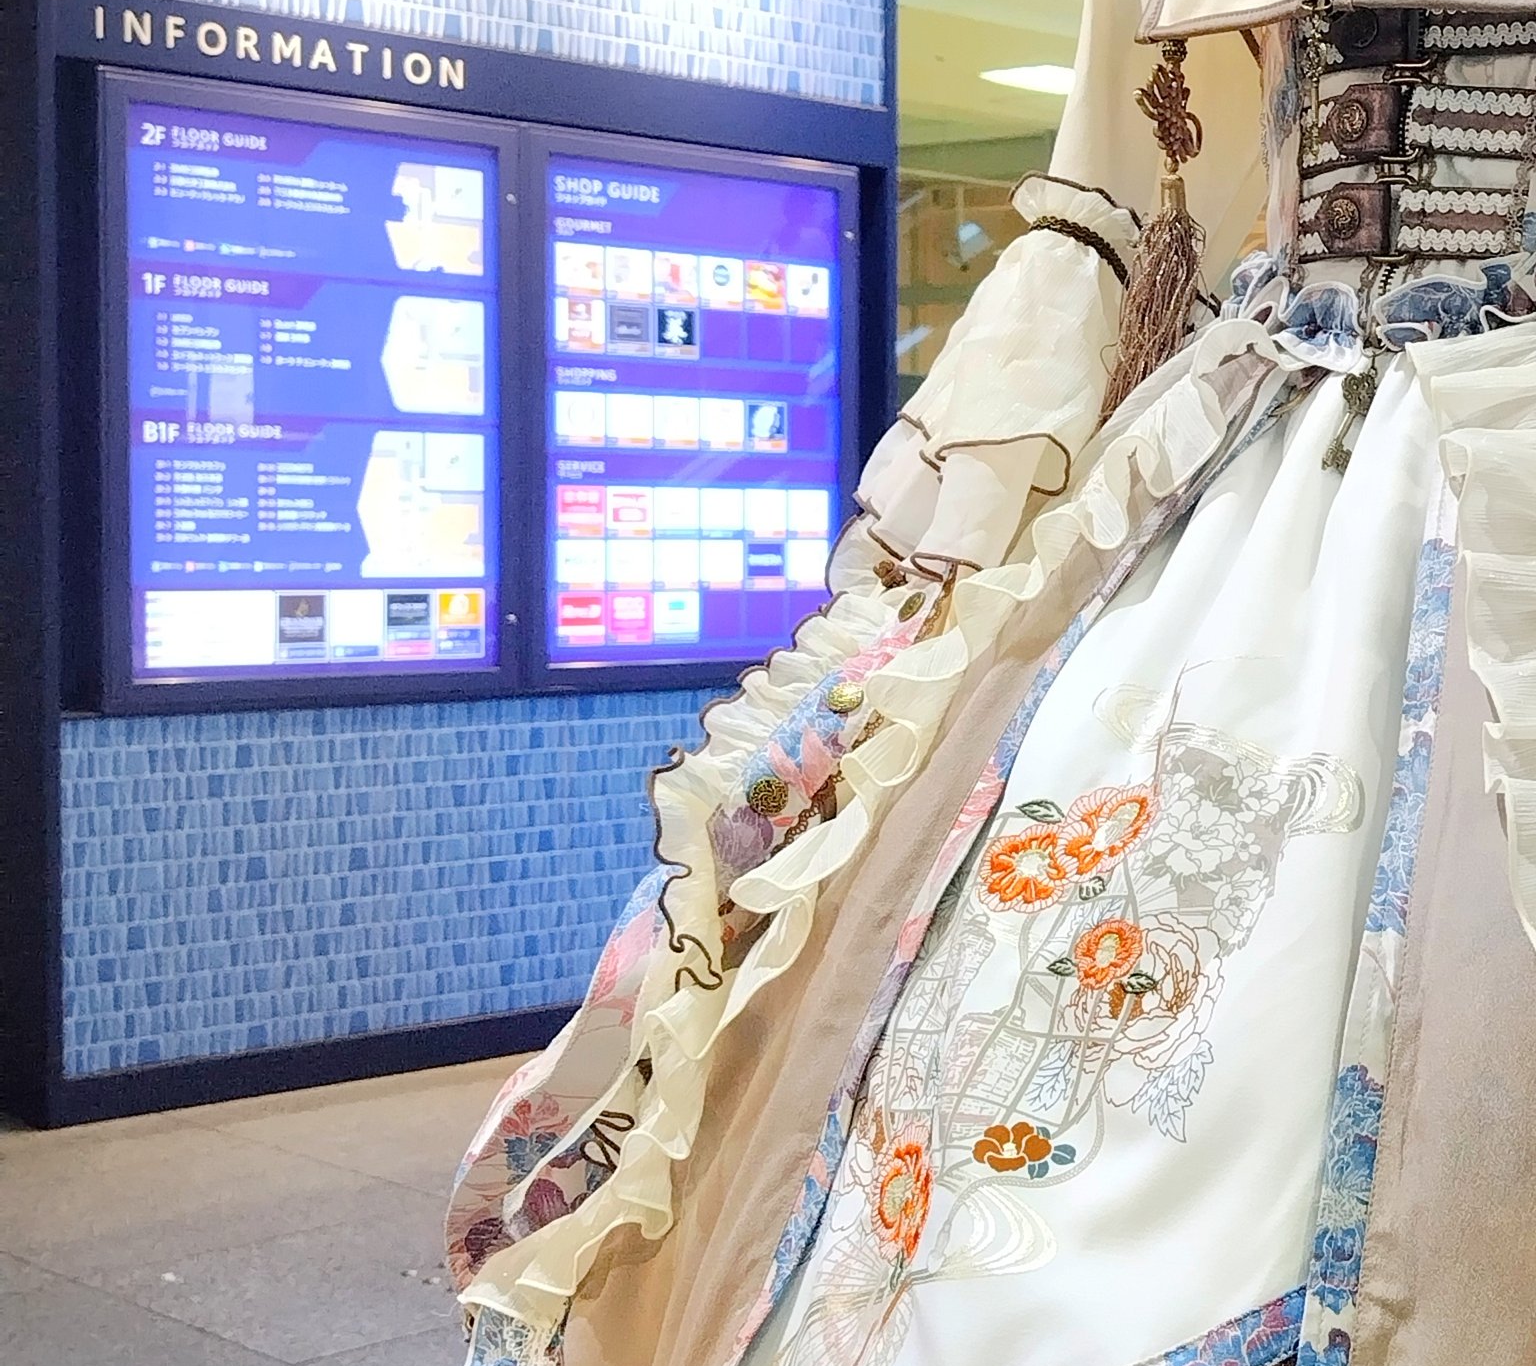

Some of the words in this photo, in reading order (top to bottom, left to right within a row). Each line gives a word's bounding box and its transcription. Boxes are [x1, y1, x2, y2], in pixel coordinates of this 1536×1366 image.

[94, 5, 466, 91] INFORMATION
[140, 122, 167, 146] 2F
[171, 125, 220, 143] FLOOR
[222, 132, 268, 150] GUIDE
[553, 175, 603, 195] SHOP
[606, 181, 661, 203] GUIDE
[142, 272, 167, 295] 1F
[172, 274, 222, 290] FLOOR
[224, 278, 270, 296] GUIDE
[142, 420, 180, 443] B1F
[186, 421, 236, 436] FLOOR
[237, 422, 282, 439] GUIDE
